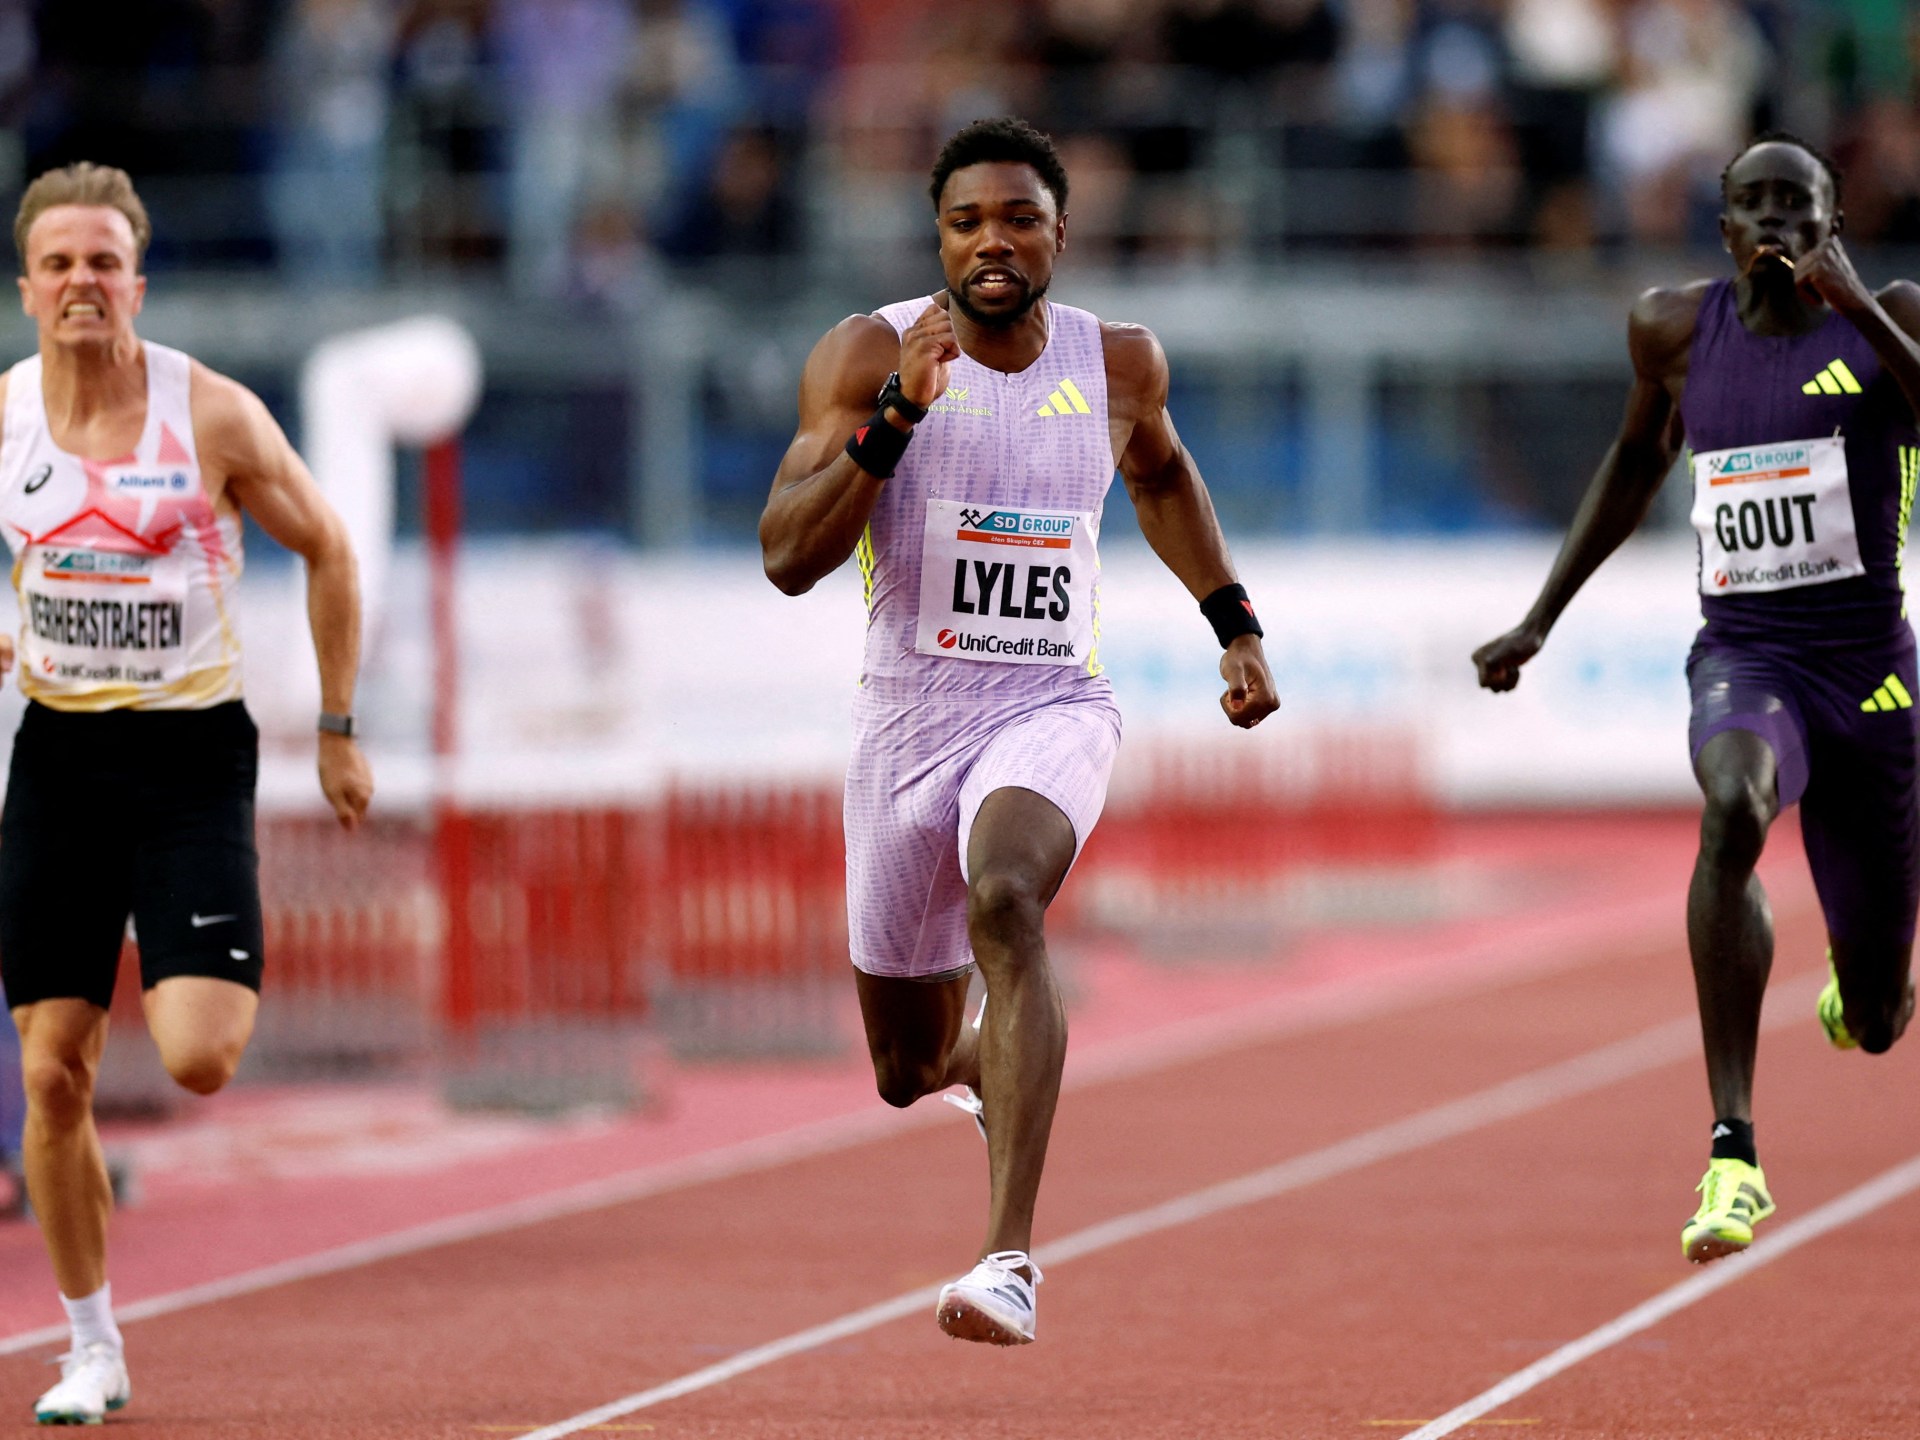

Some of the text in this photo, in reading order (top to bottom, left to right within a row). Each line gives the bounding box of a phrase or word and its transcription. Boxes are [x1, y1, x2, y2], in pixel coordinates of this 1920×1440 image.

[959, 404, 993, 416] Angels
[1755, 449, 1804, 465] GROUP
[993, 515, 1071, 533] SD GROUP
[1715, 493, 1816, 553] GOUT
[1006, 538, 1031, 546] Skupiny
[1728, 557, 1839, 585] UniCredit Bank
[952, 558, 1071, 622] LYLES
[28, 590, 183, 649] VERHERSTRAETEN
[958, 632, 1075, 658] UniCredit Bank
